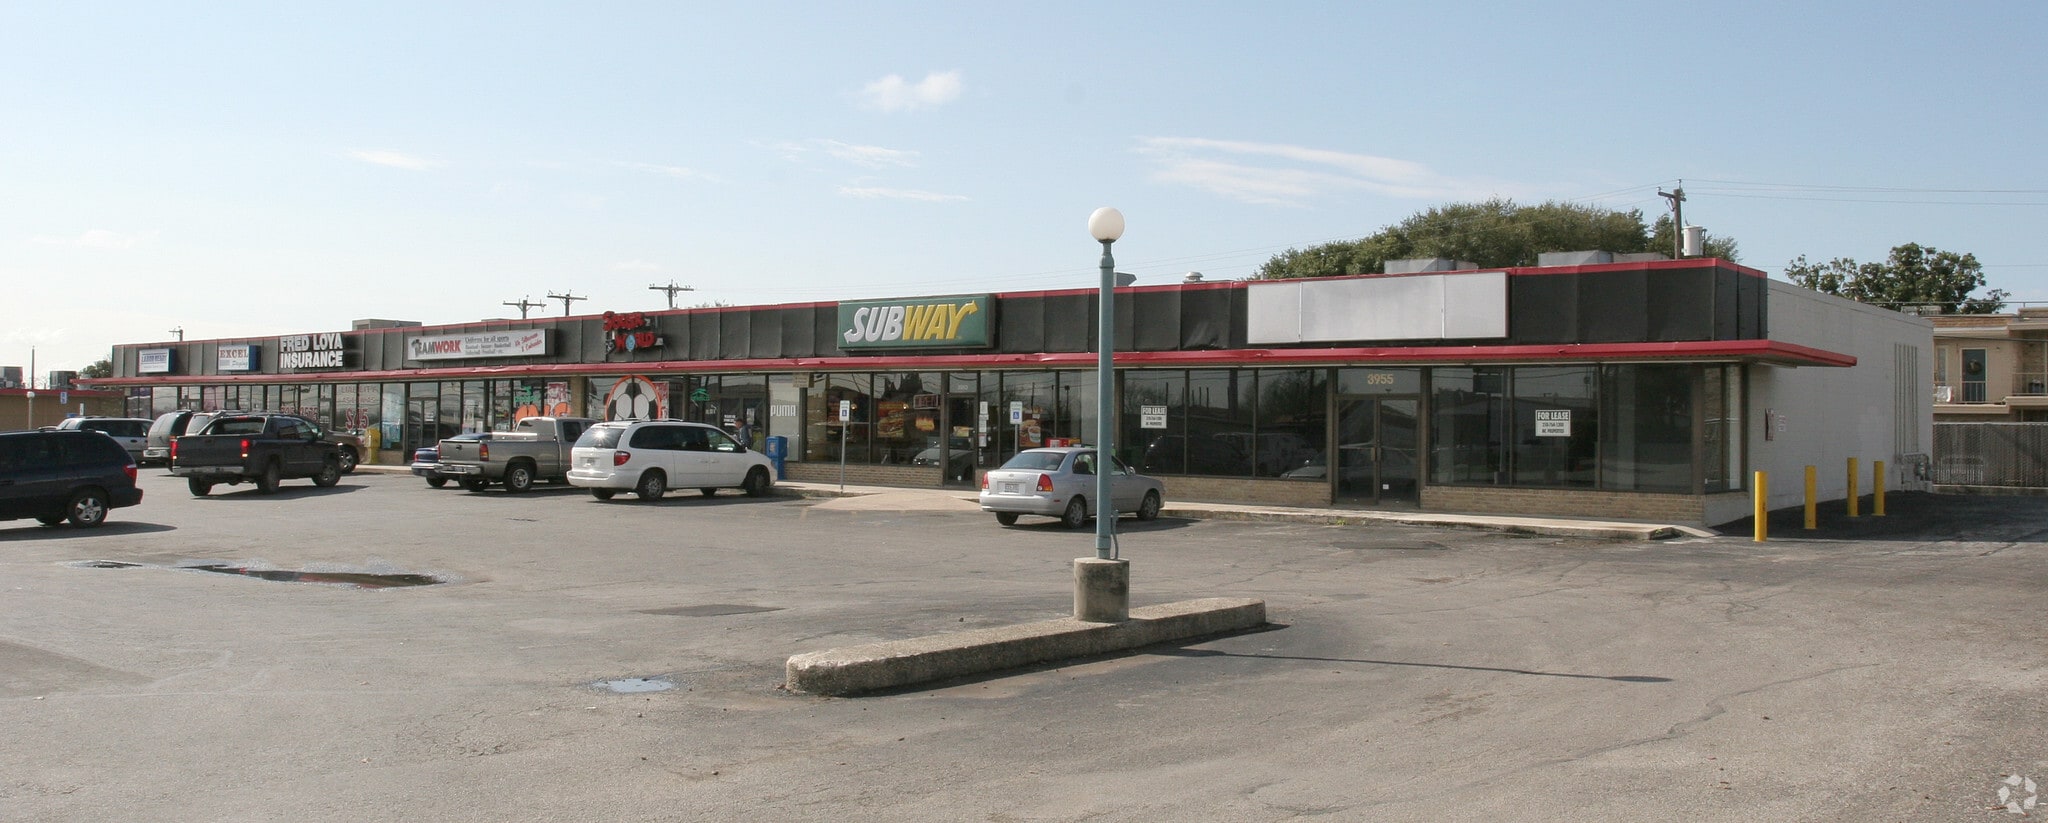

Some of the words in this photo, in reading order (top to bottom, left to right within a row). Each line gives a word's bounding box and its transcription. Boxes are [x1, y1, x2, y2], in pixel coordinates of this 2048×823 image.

[844, 300, 979, 344] SUBWAY
[280, 336, 310, 352] FRED
[312, 332, 343, 350] LOYA
[220, 349, 248, 358] EXCEL
[280, 350, 344, 369] INSURANCE
[1367, 373, 1394, 385] 3955
[770, 404, 797, 417] PUMA
[1142, 407, 1152, 415] FOR
[1537, 411, 1550, 420] FOR
[1550, 411, 1569, 420] LEASE
